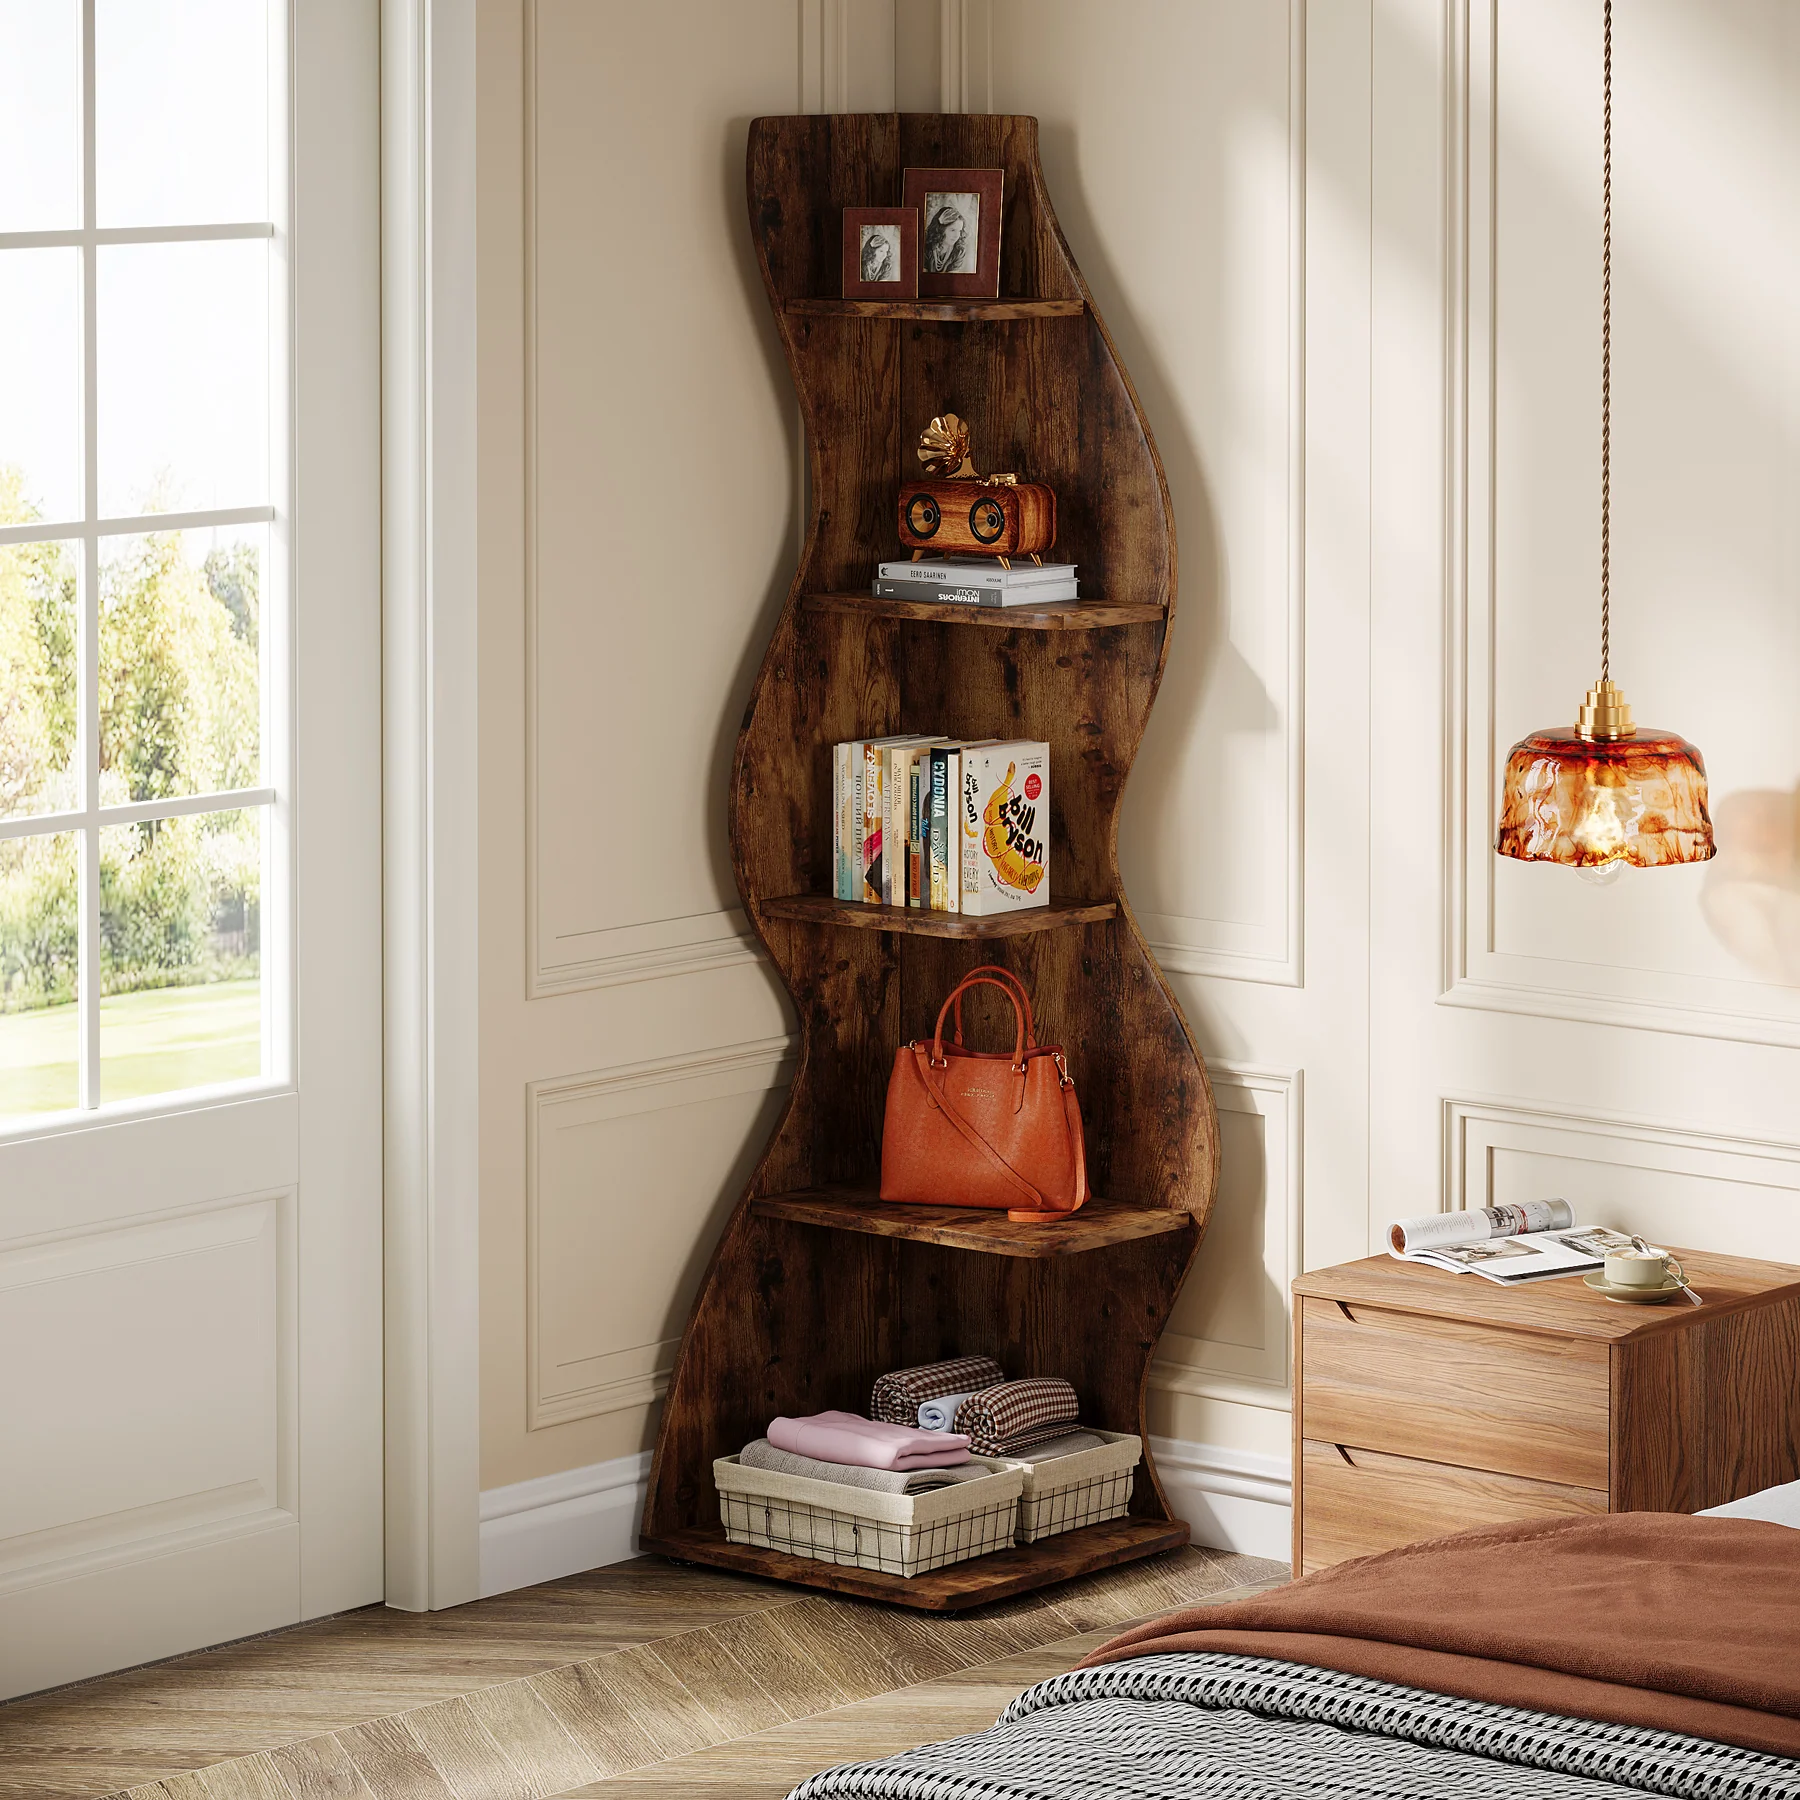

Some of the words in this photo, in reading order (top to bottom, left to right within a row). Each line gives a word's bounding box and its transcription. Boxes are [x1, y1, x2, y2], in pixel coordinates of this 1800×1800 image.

[910, 570, 922, 578] EERO
[923, 571, 947, 580] SAARINEN
[938, 594, 980, 603] INTERIORS
[956, 589, 980, 597] NOW!
[855, 775, 863, 825] ПОНТИЙ
[866, 750, 876, 819] SLOVENKY
[933, 761, 945, 818] CYDONIA
[964, 773, 978, 823] bryson
[999, 802, 1043, 863] bryson
[1009, 794, 1036, 835] bill
[932, 829, 940, 884] DAVID
[964, 867, 979, 880] EVERY
